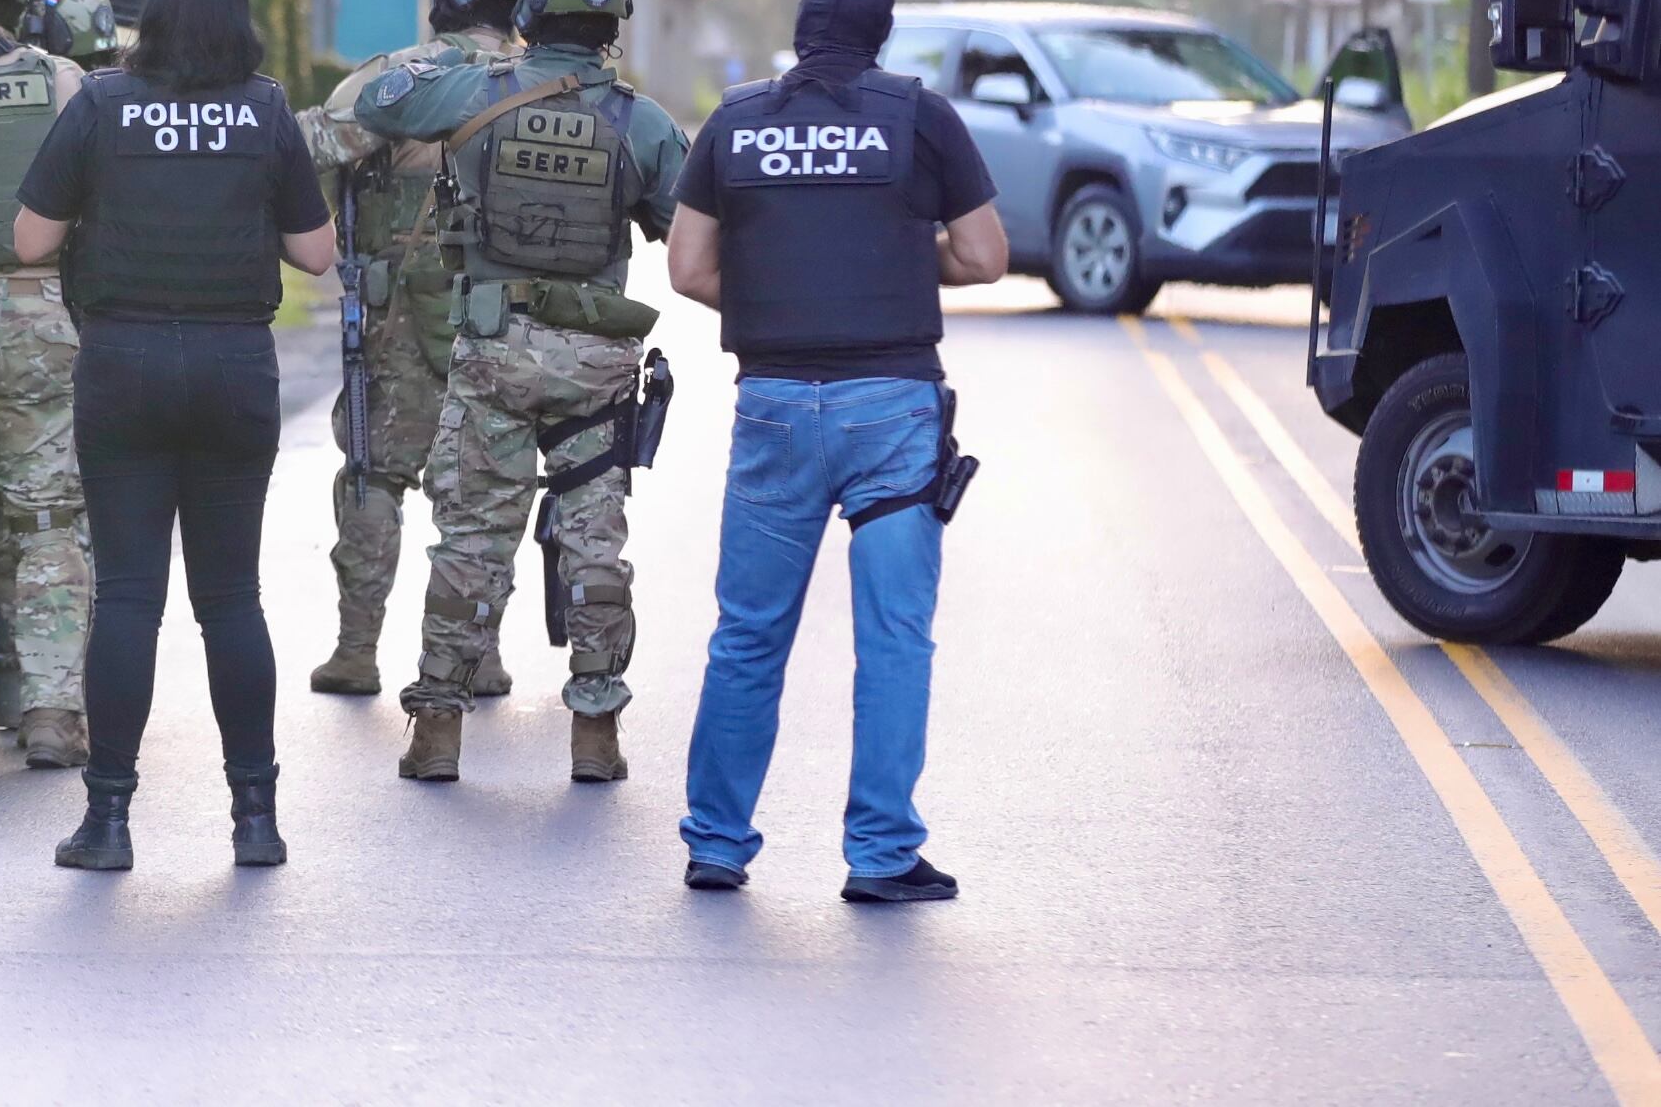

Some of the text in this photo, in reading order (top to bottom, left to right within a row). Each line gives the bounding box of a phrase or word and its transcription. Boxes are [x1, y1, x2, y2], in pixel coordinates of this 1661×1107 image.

[122, 102, 259, 127] POLICIA
[527, 114, 583, 138] OIJ
[732, 125, 889, 153] POLICIA
[515, 150, 589, 176] SERT
[760, 151, 858, 176] O.I.J.
